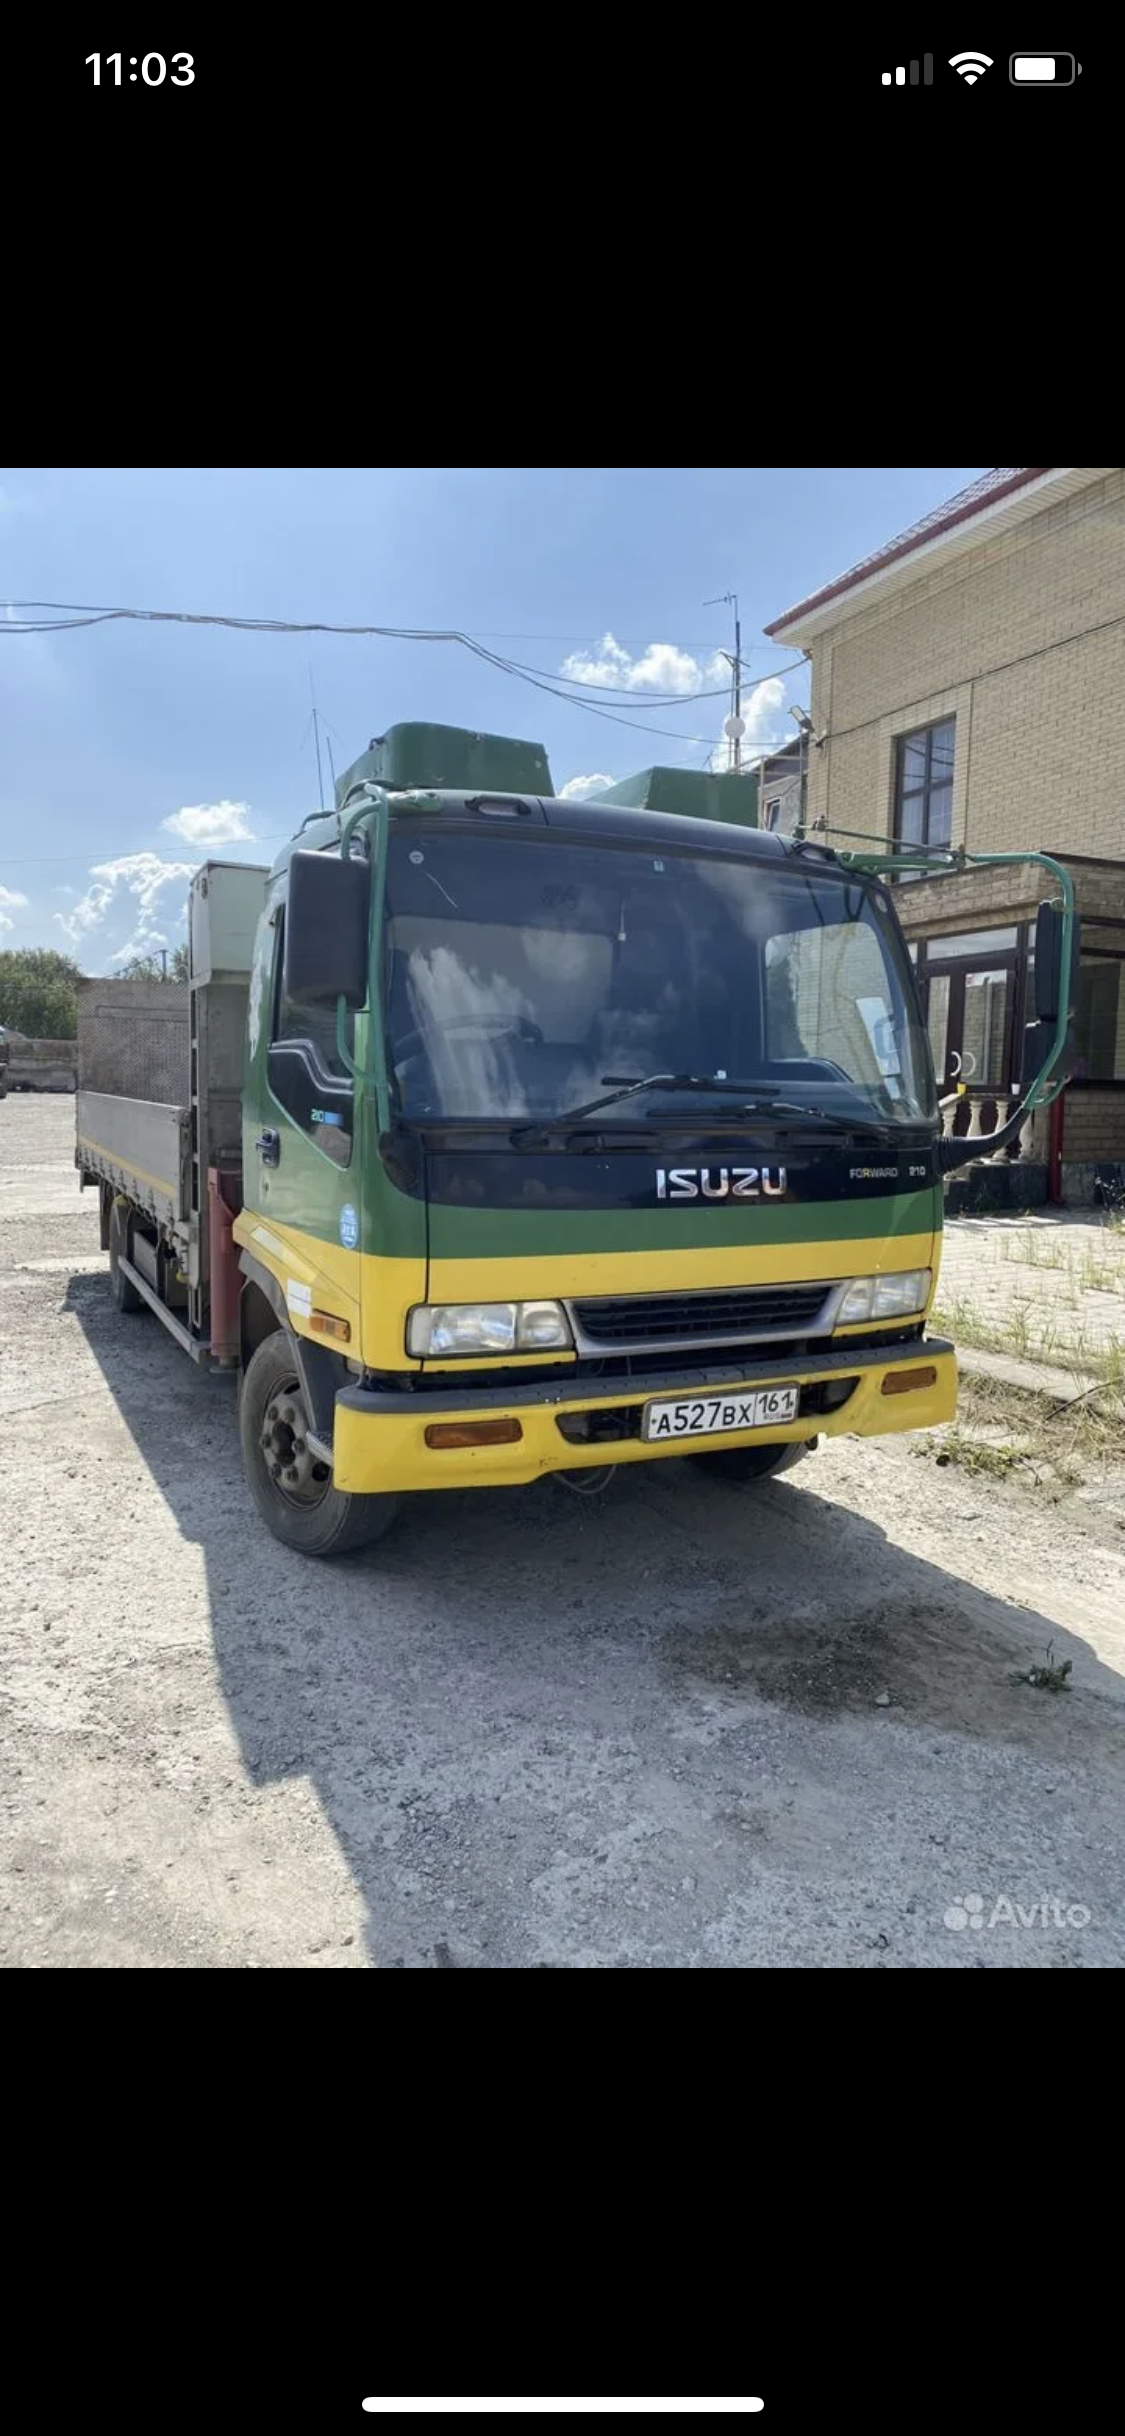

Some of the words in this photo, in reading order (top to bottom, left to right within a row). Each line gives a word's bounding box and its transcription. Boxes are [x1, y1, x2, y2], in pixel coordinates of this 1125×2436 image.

[656, 1167, 787, 1199] ISUZU
[849, 1167, 898, 1179] FORWARD
[758, 1390, 791, 1413] 161
